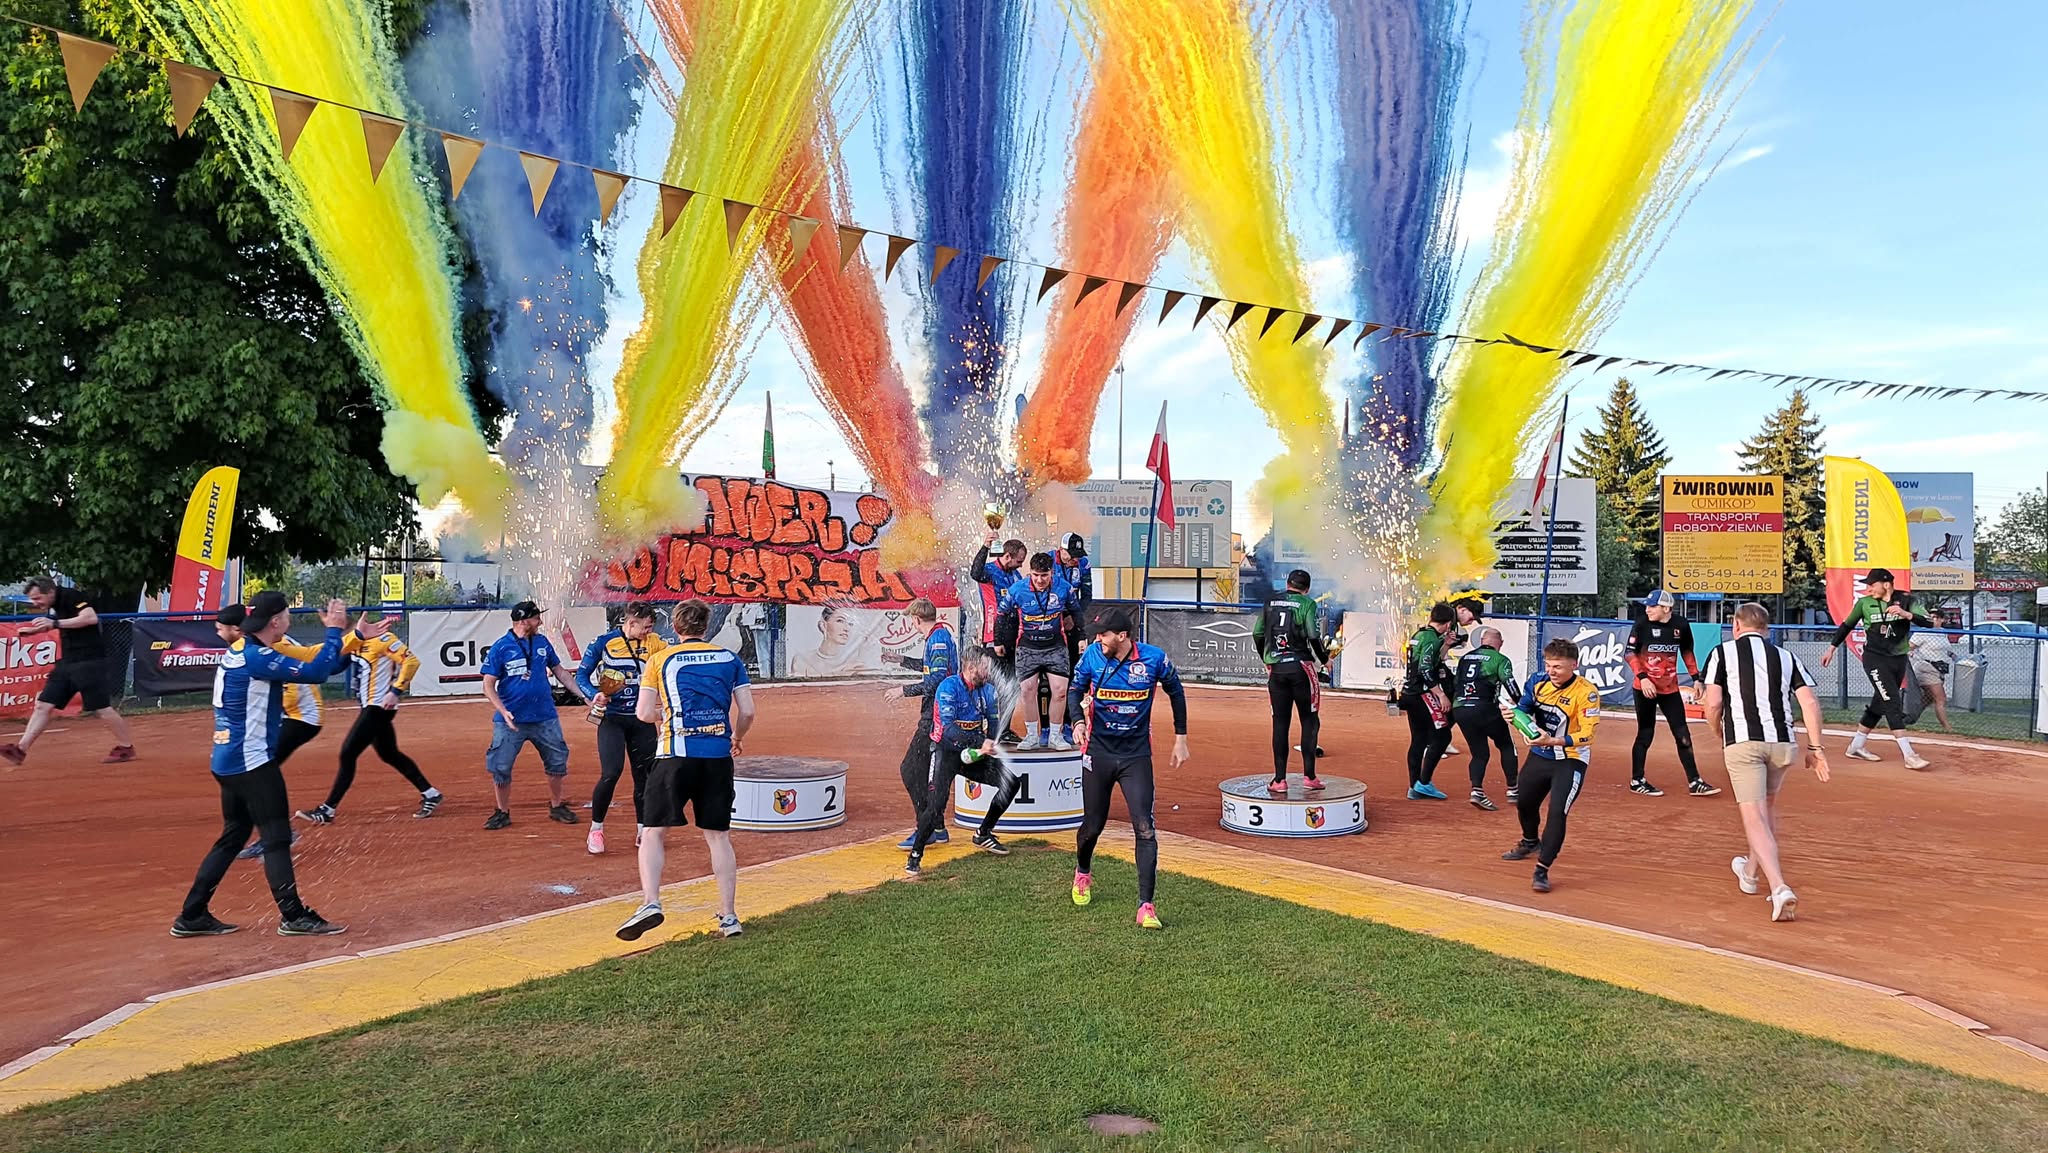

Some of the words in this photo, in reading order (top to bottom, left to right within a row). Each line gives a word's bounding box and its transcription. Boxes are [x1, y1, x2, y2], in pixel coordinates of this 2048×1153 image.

[1672, 479, 1775, 496] ŻWIROWNIA
[201, 481, 221, 560] RAMIRENT
[1687, 513, 1760, 522] TRANSPORT
[1673, 523, 1724, 532] ROBOTY
[1727, 523, 1773, 532] ZIEMNE
[1683, 569, 1778, 578] 65-549-44-24
[1683, 581, 1772, 591] 608-079-183
[1279, 611, 1287, 627] 1
[676, 654, 717, 662] BARTEK
[1466, 664, 1477, 678] 5
[1573, 665, 1627, 688] AK
[1014, 772, 1035, 804] 1
[823, 785, 837, 813] 2
[1248, 805, 1264, 827] 3
[1352, 801, 1361, 824] 3
